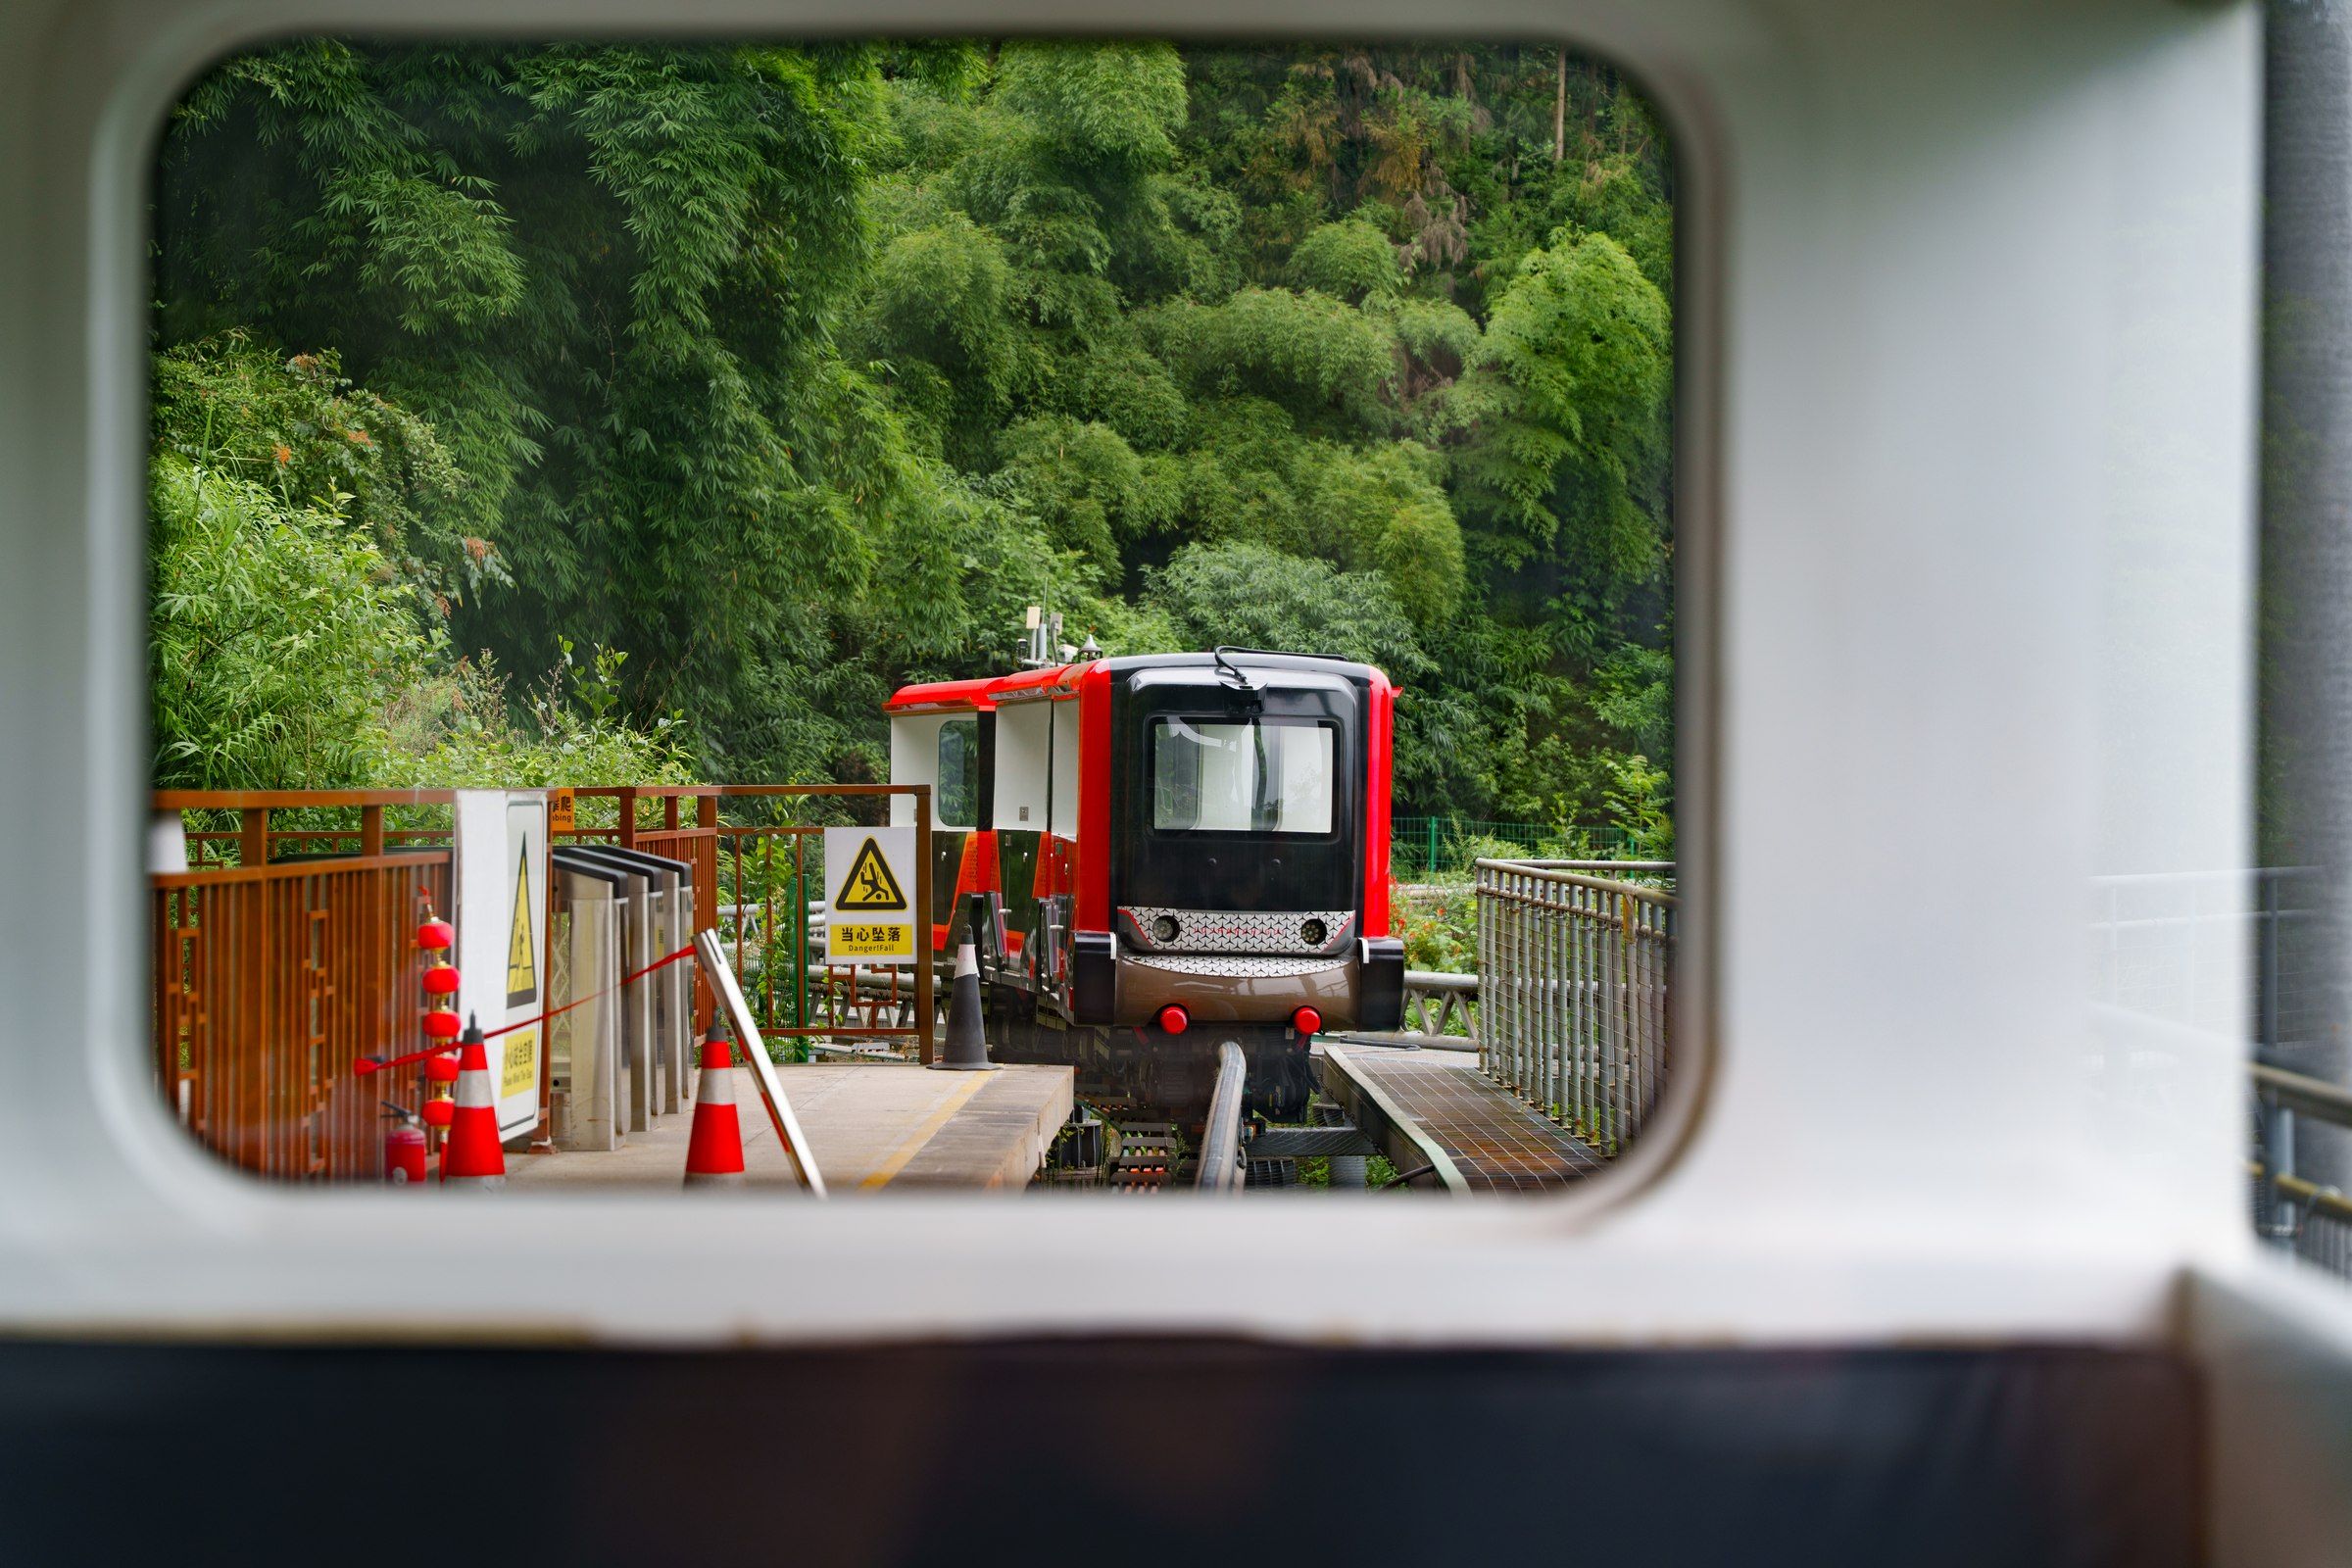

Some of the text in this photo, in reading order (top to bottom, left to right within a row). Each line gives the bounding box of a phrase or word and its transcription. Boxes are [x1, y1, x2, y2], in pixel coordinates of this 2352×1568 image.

[841, 927, 901, 942] 当心坠落
[848, 944, 895, 954] Danger!Fall
